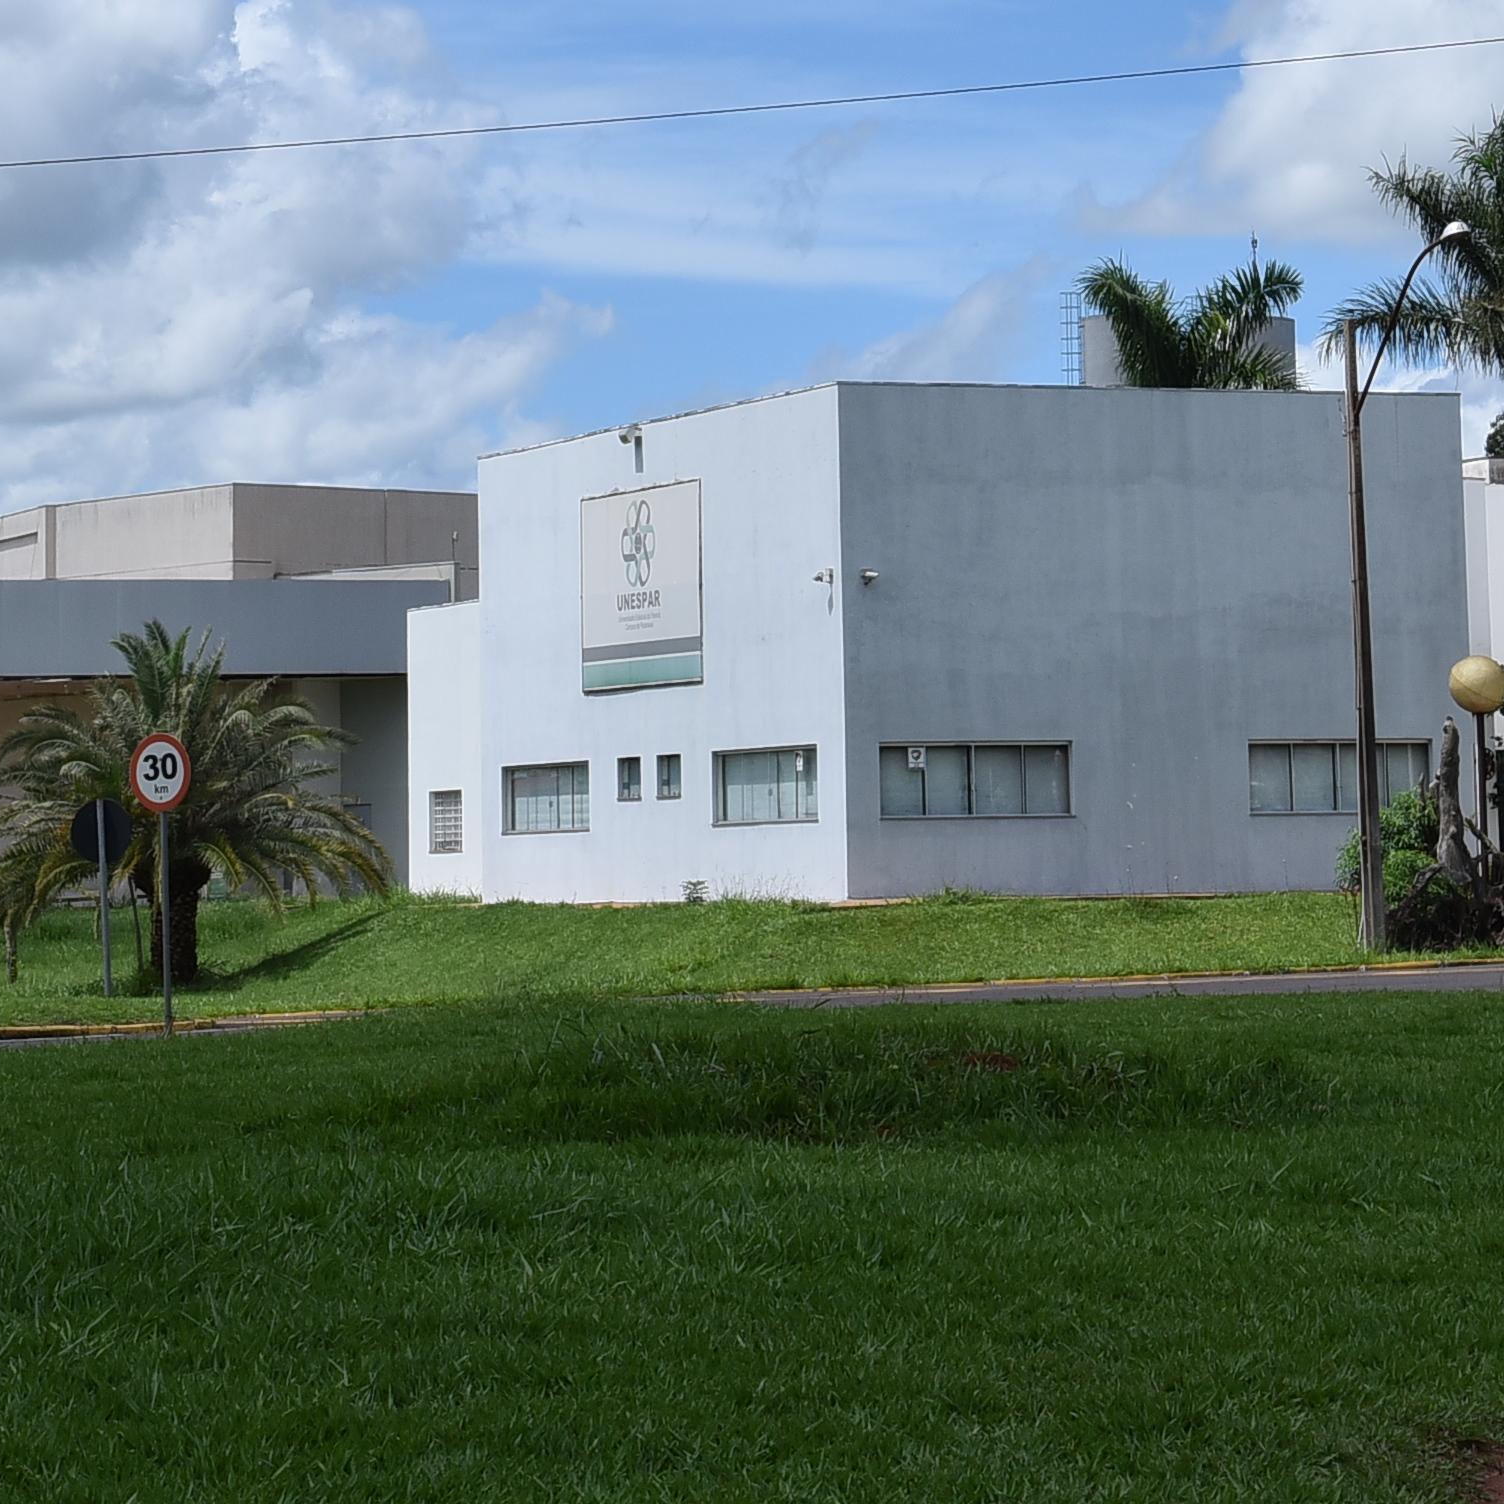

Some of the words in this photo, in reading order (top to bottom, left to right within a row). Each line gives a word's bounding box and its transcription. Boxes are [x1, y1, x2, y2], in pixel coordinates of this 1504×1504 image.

[616, 589, 661, 611] UNESPAR
[143, 752, 178, 781] 30
[154, 783, 169, 794] km
